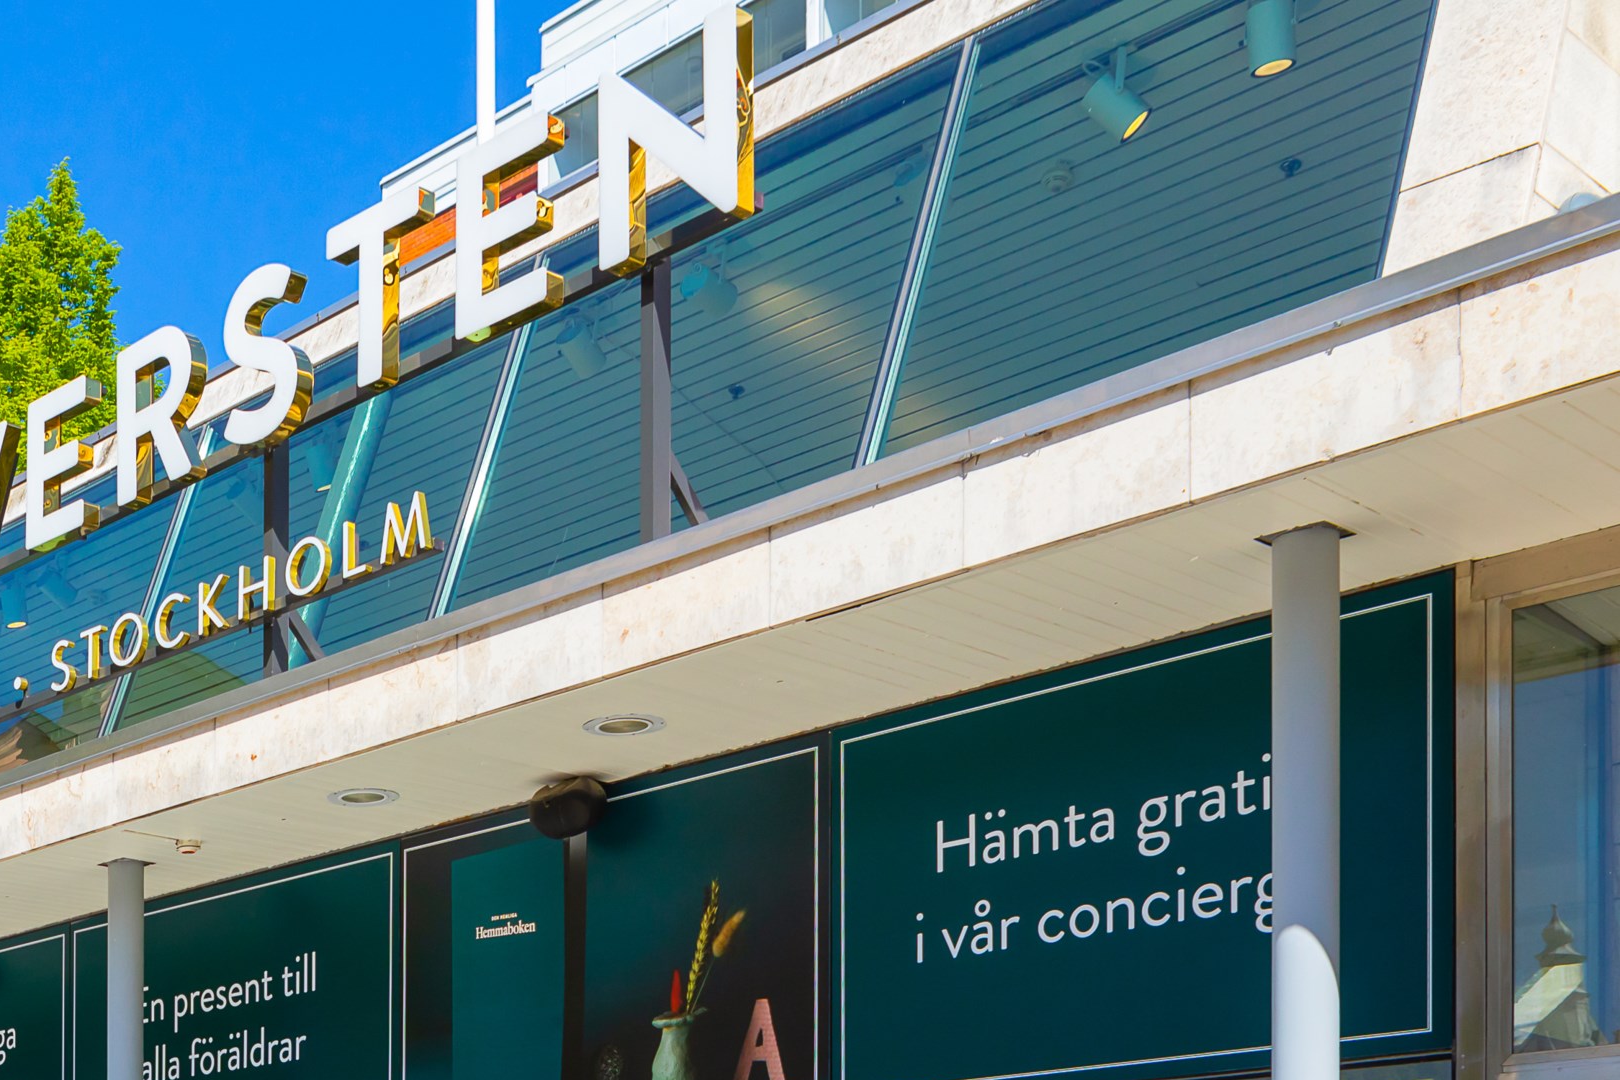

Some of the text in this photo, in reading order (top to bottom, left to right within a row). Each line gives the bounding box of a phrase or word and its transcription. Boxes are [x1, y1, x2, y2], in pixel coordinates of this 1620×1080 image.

[48, 489, 437, 696] STOCKHOLM
[934, 753, 1271, 875] Hämta grati
[475, 920, 536, 939] Hemmaboken
[914, 866, 1273, 964] i vår concierg
[174, 968, 273, 1034] present
[281, 951, 317, 996] till
[188, 1028, 307, 1078] föräldrar
